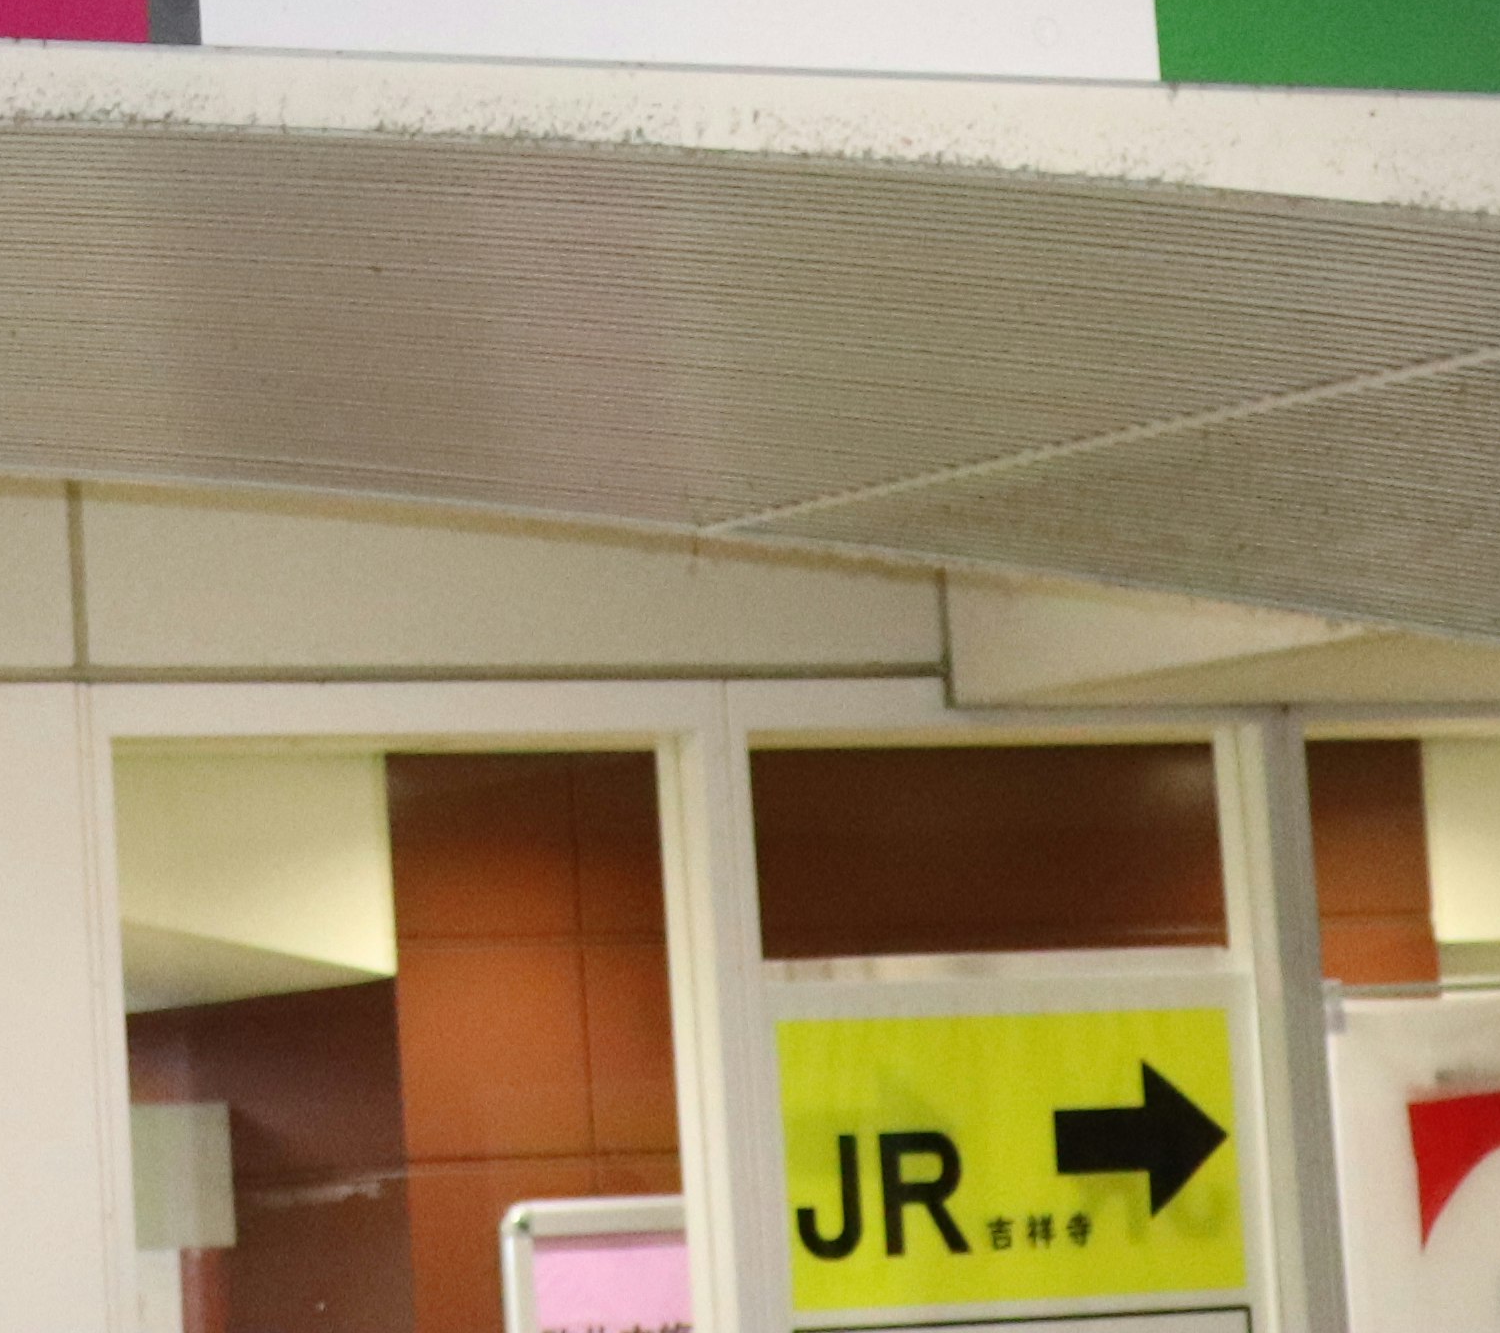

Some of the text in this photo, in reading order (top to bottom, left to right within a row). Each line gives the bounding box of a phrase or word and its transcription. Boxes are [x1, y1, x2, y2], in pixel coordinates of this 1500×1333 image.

[796, 1130, 1093, 1261] JR 吉祥寺
